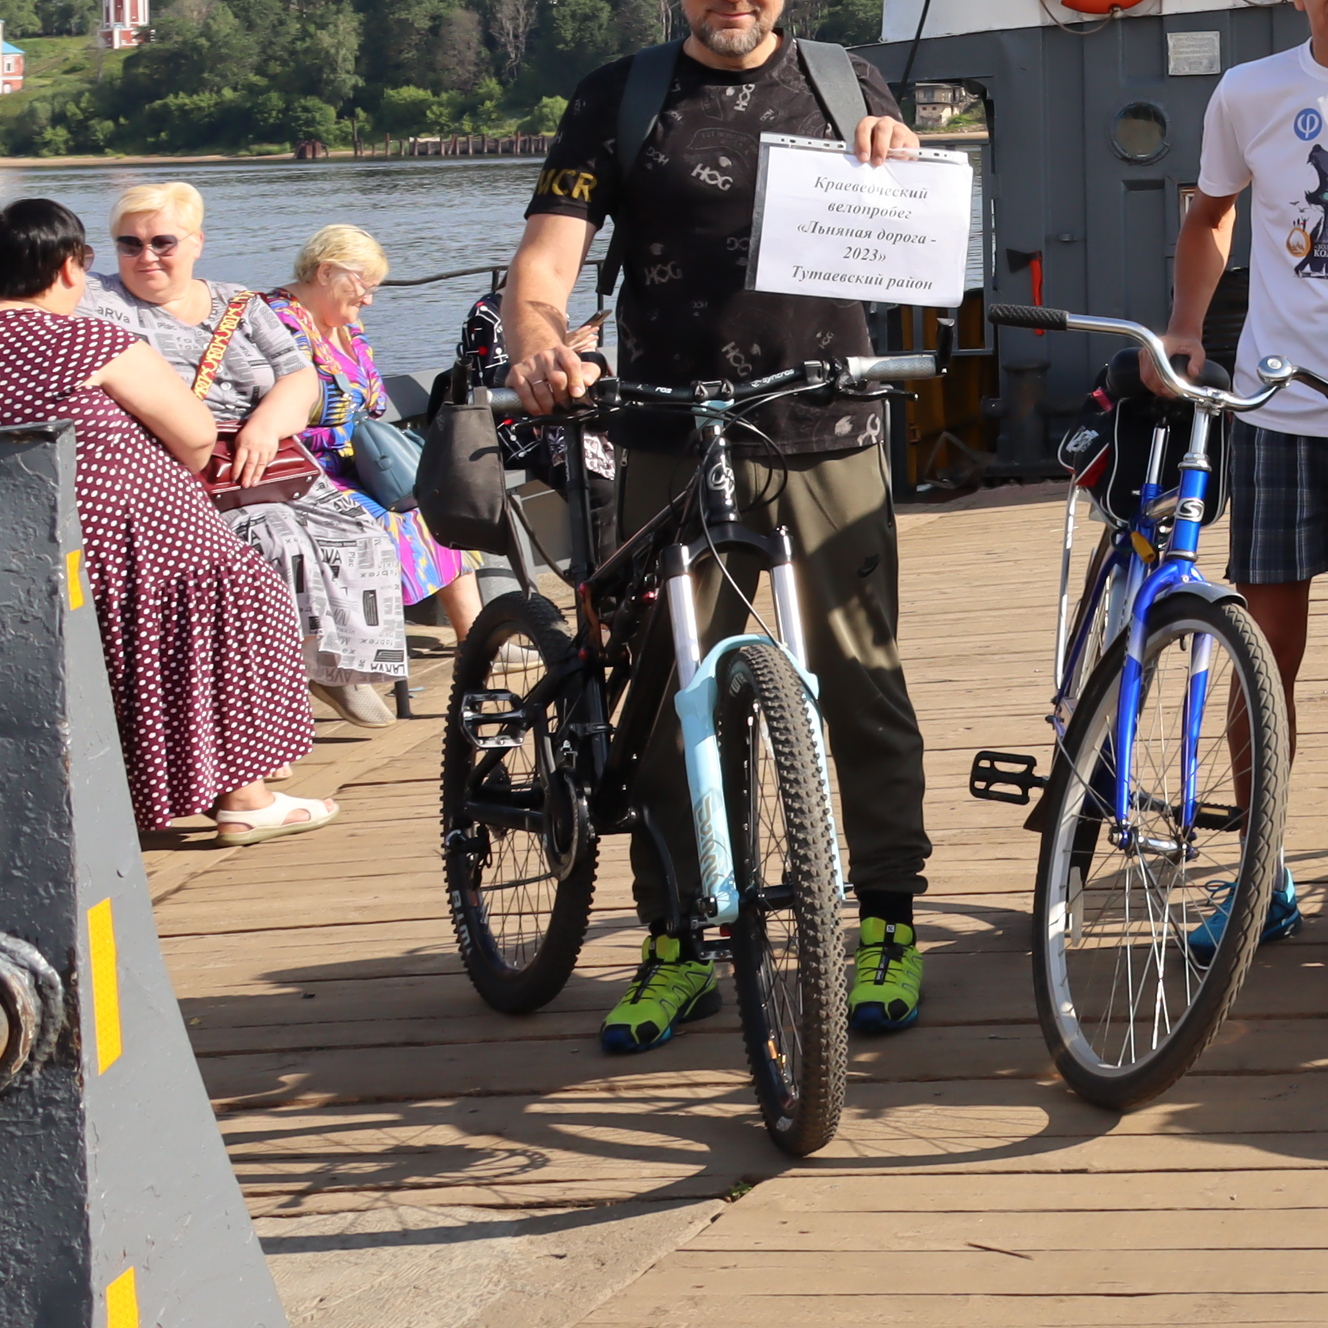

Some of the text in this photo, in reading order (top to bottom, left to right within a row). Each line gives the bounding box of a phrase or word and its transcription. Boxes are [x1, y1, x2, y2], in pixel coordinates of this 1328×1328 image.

[813, 175, 928, 200] Краеведческий
[827, 201, 912, 220] велопробег
[797, 220, 873, 240] «Льняная
[875, 227, 927, 246] дорога
[843, 246, 887, 263] 2023»
[792, 265, 933, 290] Тутаевский район
